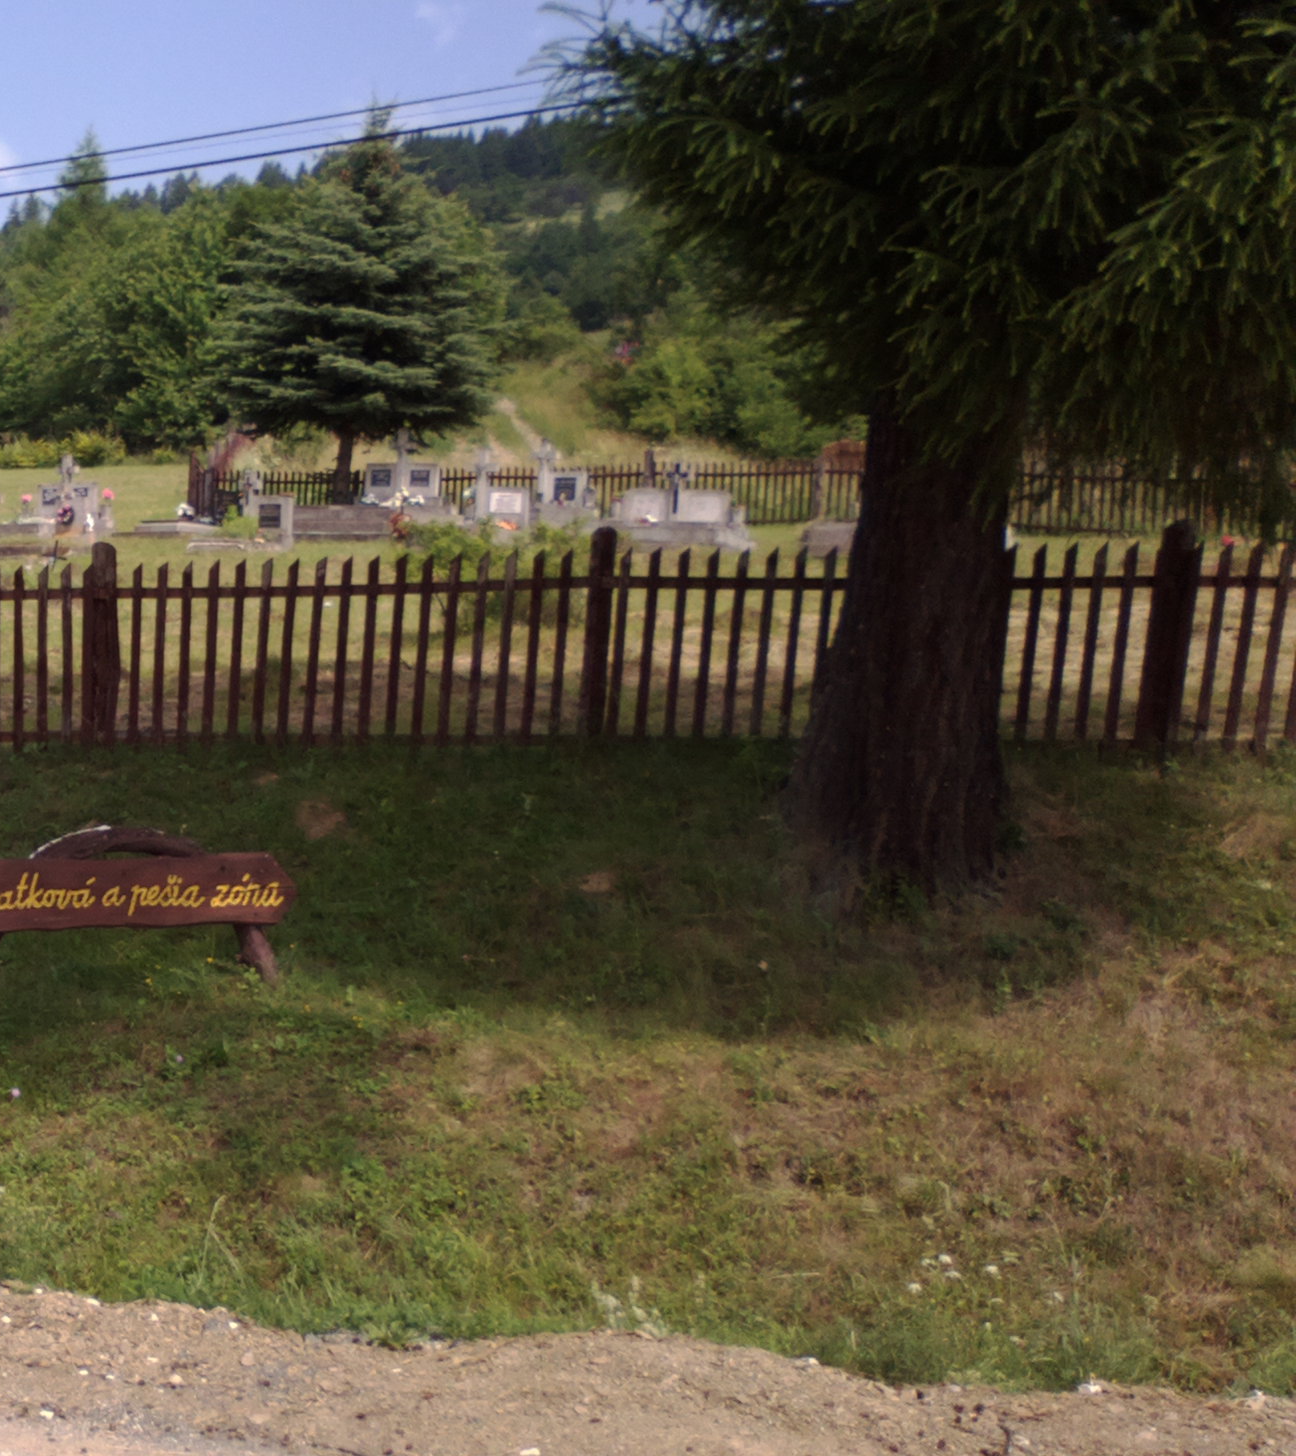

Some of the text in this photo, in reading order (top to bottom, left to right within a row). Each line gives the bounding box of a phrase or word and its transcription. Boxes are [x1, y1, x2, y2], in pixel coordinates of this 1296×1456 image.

[102, 886, 126, 907] a
[128, 874, 206, 916] pešia
[210, 873, 284, 907] zóna
